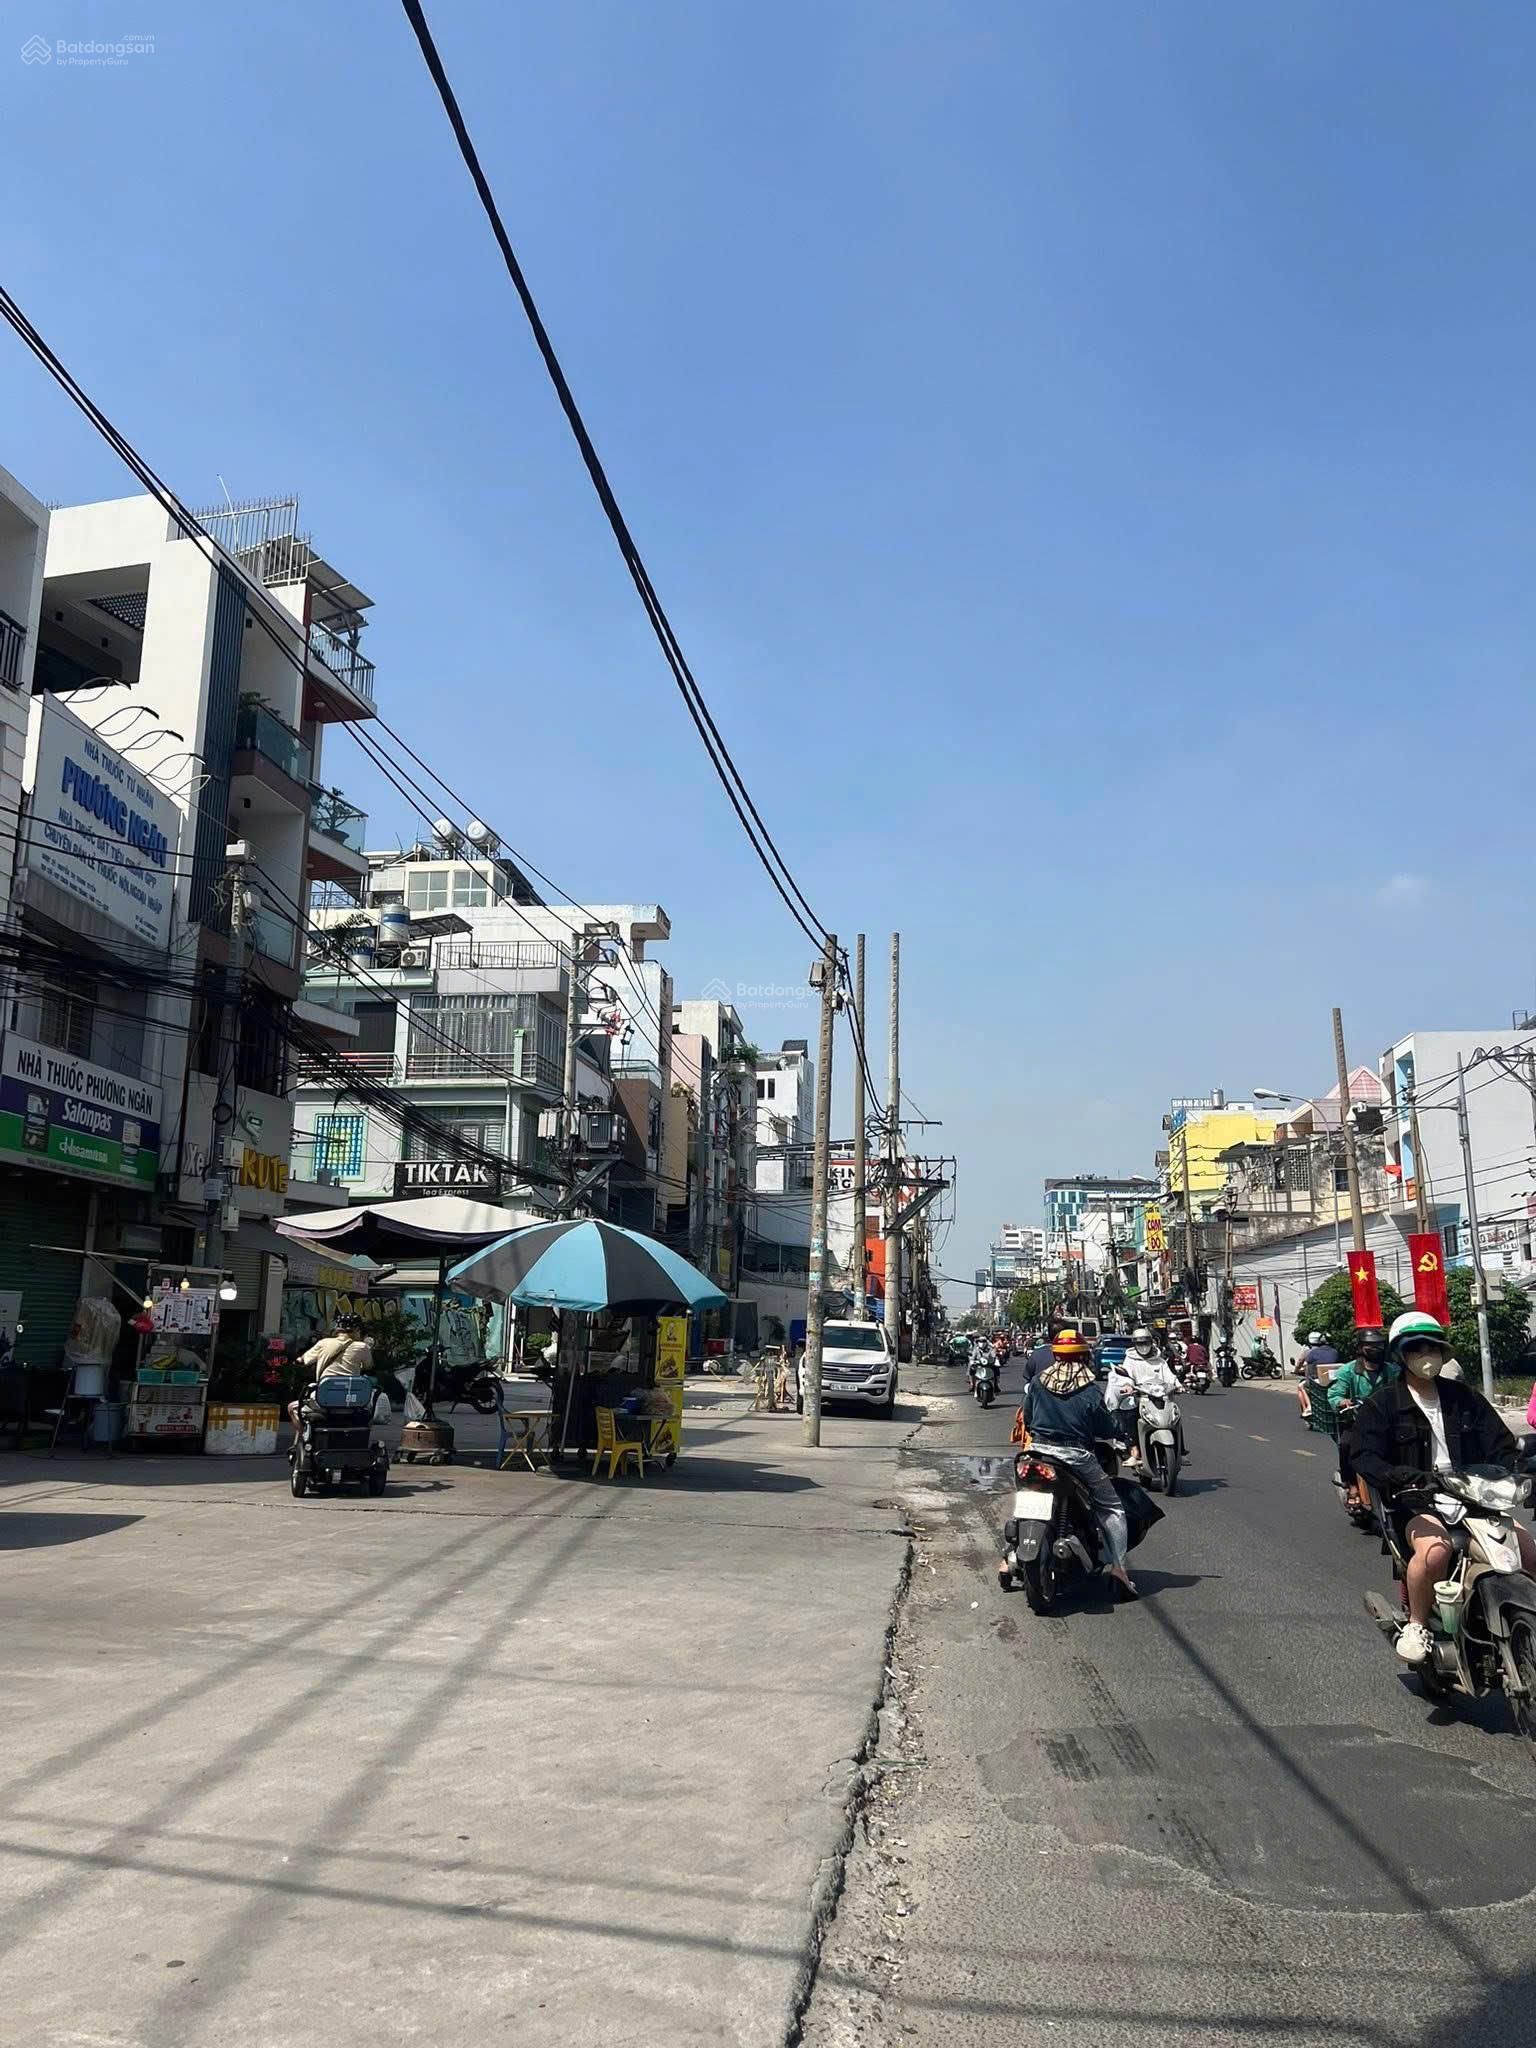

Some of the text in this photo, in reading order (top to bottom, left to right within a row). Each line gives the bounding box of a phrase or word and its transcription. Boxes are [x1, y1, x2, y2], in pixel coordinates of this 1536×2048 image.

[61, 755, 168, 869] PHƯƠNG NGÂN
[17, 1050, 152, 1116] NHÀ THUỐC PHƯƠNG NGÂN
[62, 1098, 113, 1133] Salonpas
[240, 1147, 288, 1193] KUTE
[405, 1163, 489, 1183] TIKTAK
[439, 1188, 469, 1197] Express
